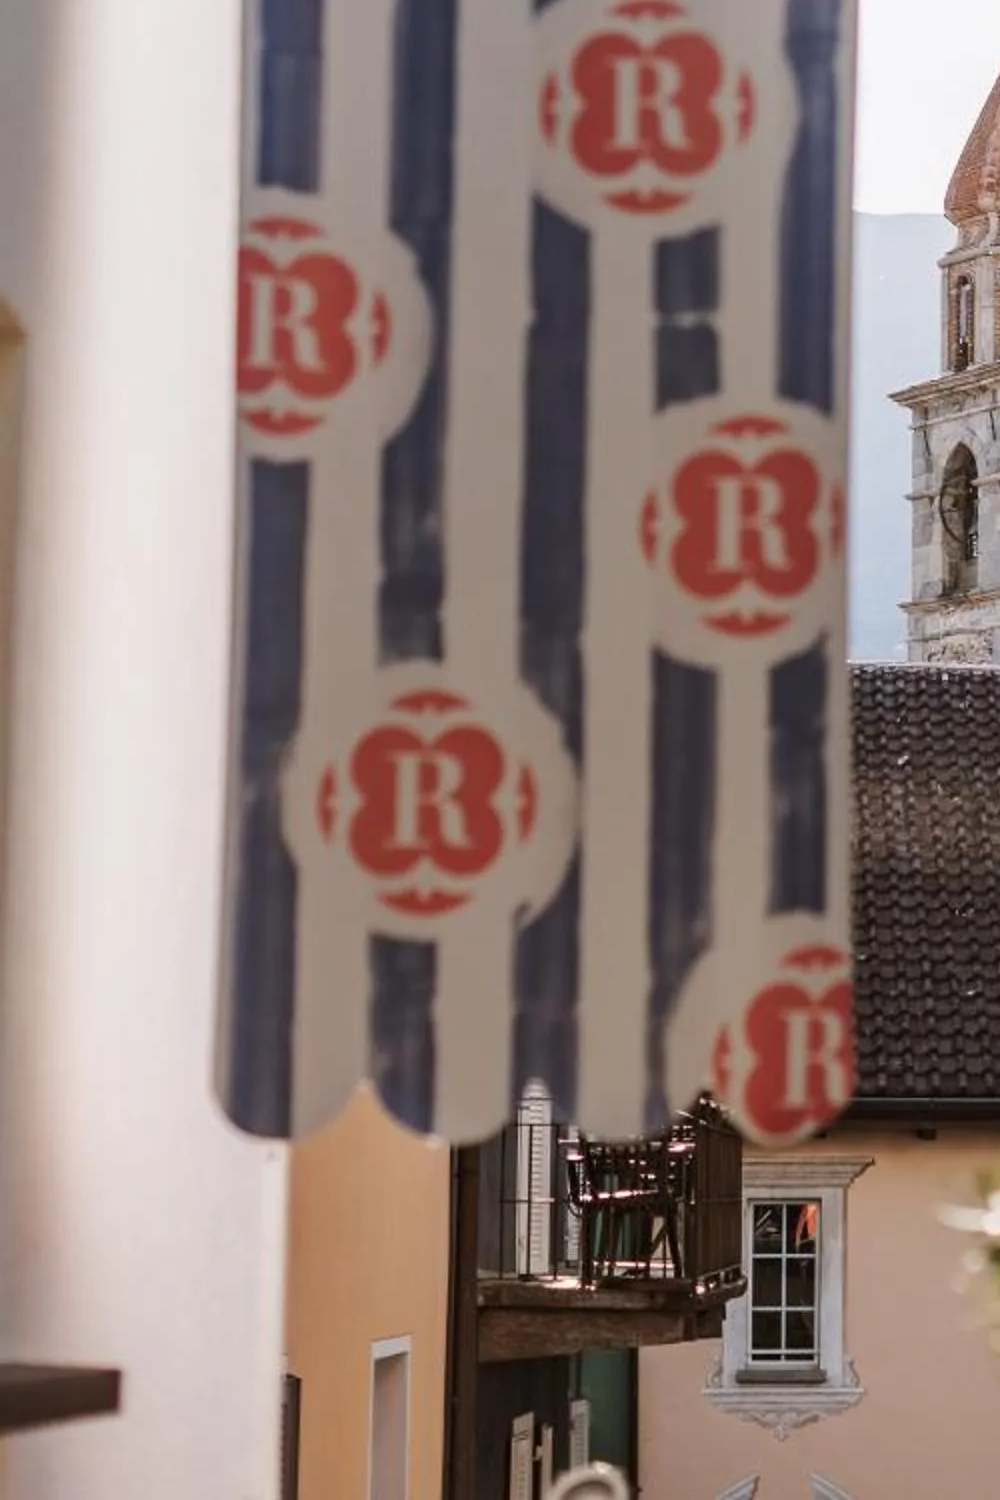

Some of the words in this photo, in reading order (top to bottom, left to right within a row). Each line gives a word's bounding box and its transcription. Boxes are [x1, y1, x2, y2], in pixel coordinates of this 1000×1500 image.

[607, 58, 690, 151] R
[244, 276, 325, 372] R
[709, 477, 791, 572] R
[388, 752, 472, 849] R
[781, 1010, 850, 1109] R
